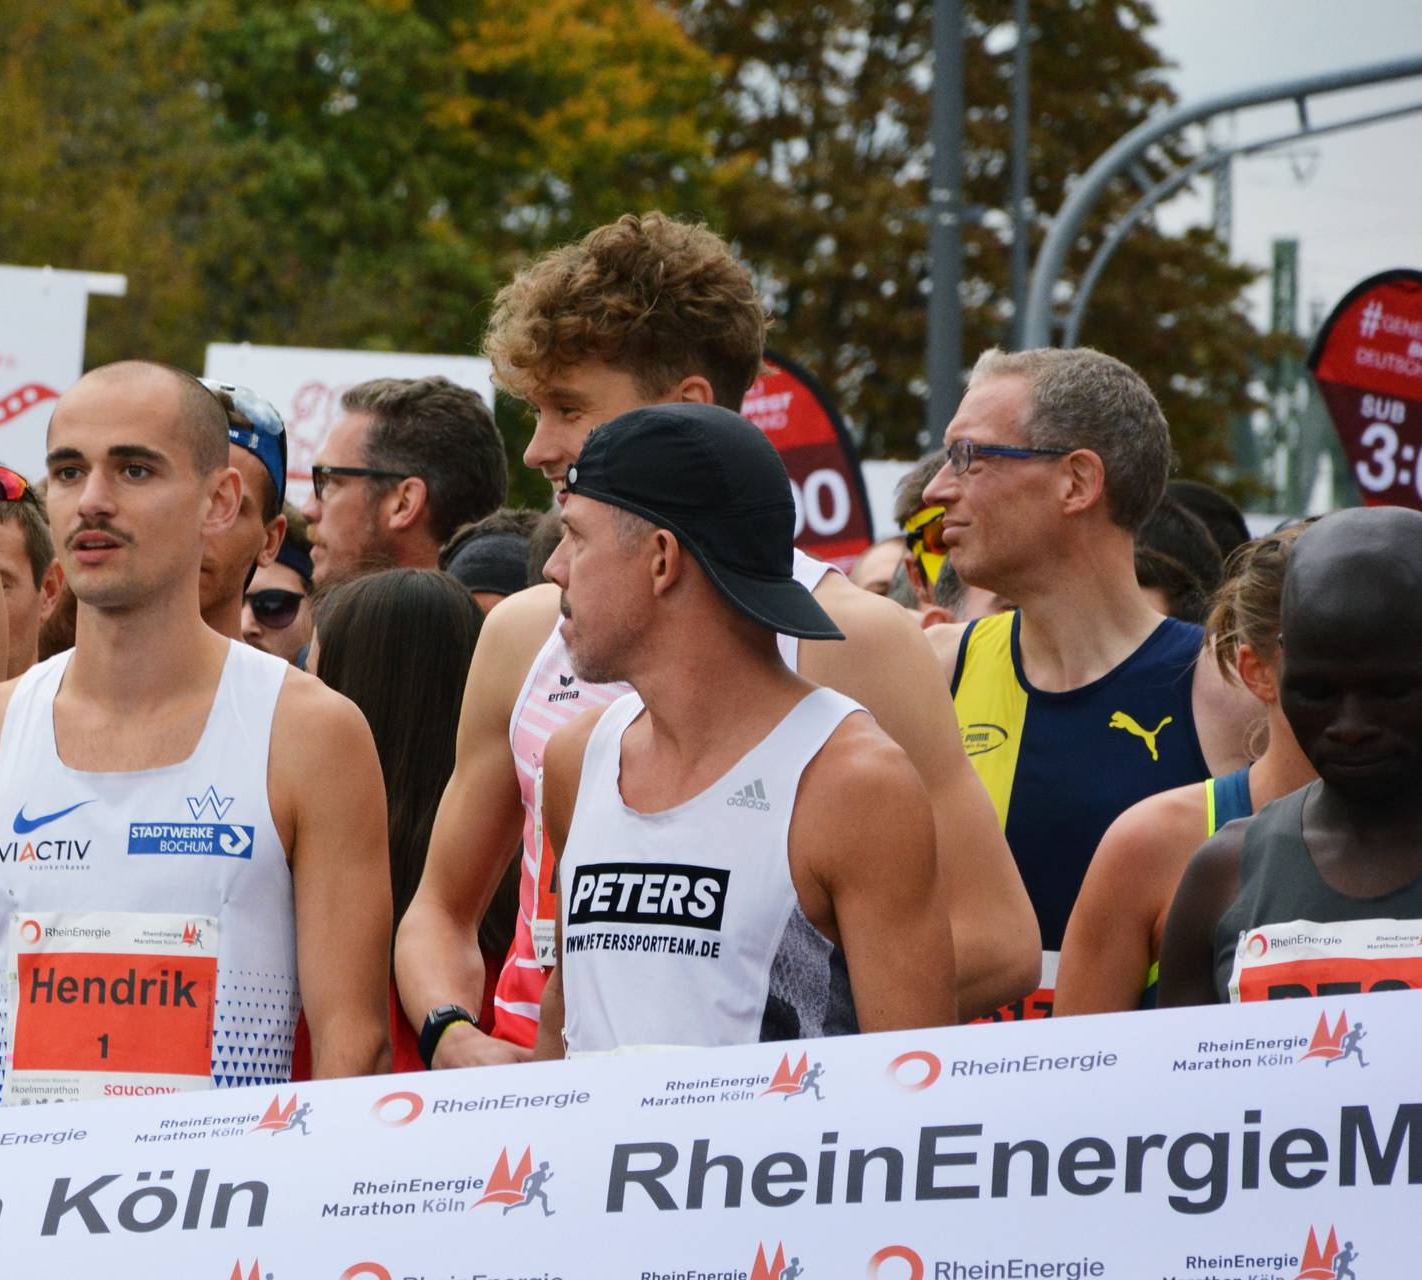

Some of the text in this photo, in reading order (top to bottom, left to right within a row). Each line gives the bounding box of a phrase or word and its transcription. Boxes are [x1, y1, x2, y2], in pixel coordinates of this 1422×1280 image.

[1360, 394, 1406, 424] SUB
[1356, 422, 1422, 493] 3:
[548, 689, 579, 702] erima
[726, 795, 771, 811] adidas
[131, 825, 214, 840] STADTWERKE
[159, 840, 213, 853] BOCHUM
[571, 873, 721, 919] PETERS
[45, 926, 111, 939] RheinEnergie
[1270, 934, 1342, 949] RheinEnergie
[29, 967, 198, 1008] Hendrik
[97, 1033, 110, 1059] 1
[1197, 1034, 1309, 1053] RheinEnergie
[950, 1051, 1118, 1079] RheinEnergie
[1172, 1052, 1294, 1072] Marathon Köln
[665, 1073, 770, 1092] RheinEnergie
[431, 1089, 591, 1116] RheinEnergie
[640, 1088, 755, 1108] Marathon Köln
[159, 1113, 261, 1130] RheinEnergie
[134, 1126, 245, 1144] Marathon Köln
[606, 1102, 1422, 1215] RheinEnergieM
[352, 1176, 484, 1197] RheinEnergie
[40, 1167, 270, 1238] Köln
[321, 1195, 466, 1218] Marathon Köln
[934, 1256, 1105, 1280] RheinEnergie
[1185, 1253, 1299, 1271] RheinEnergie
